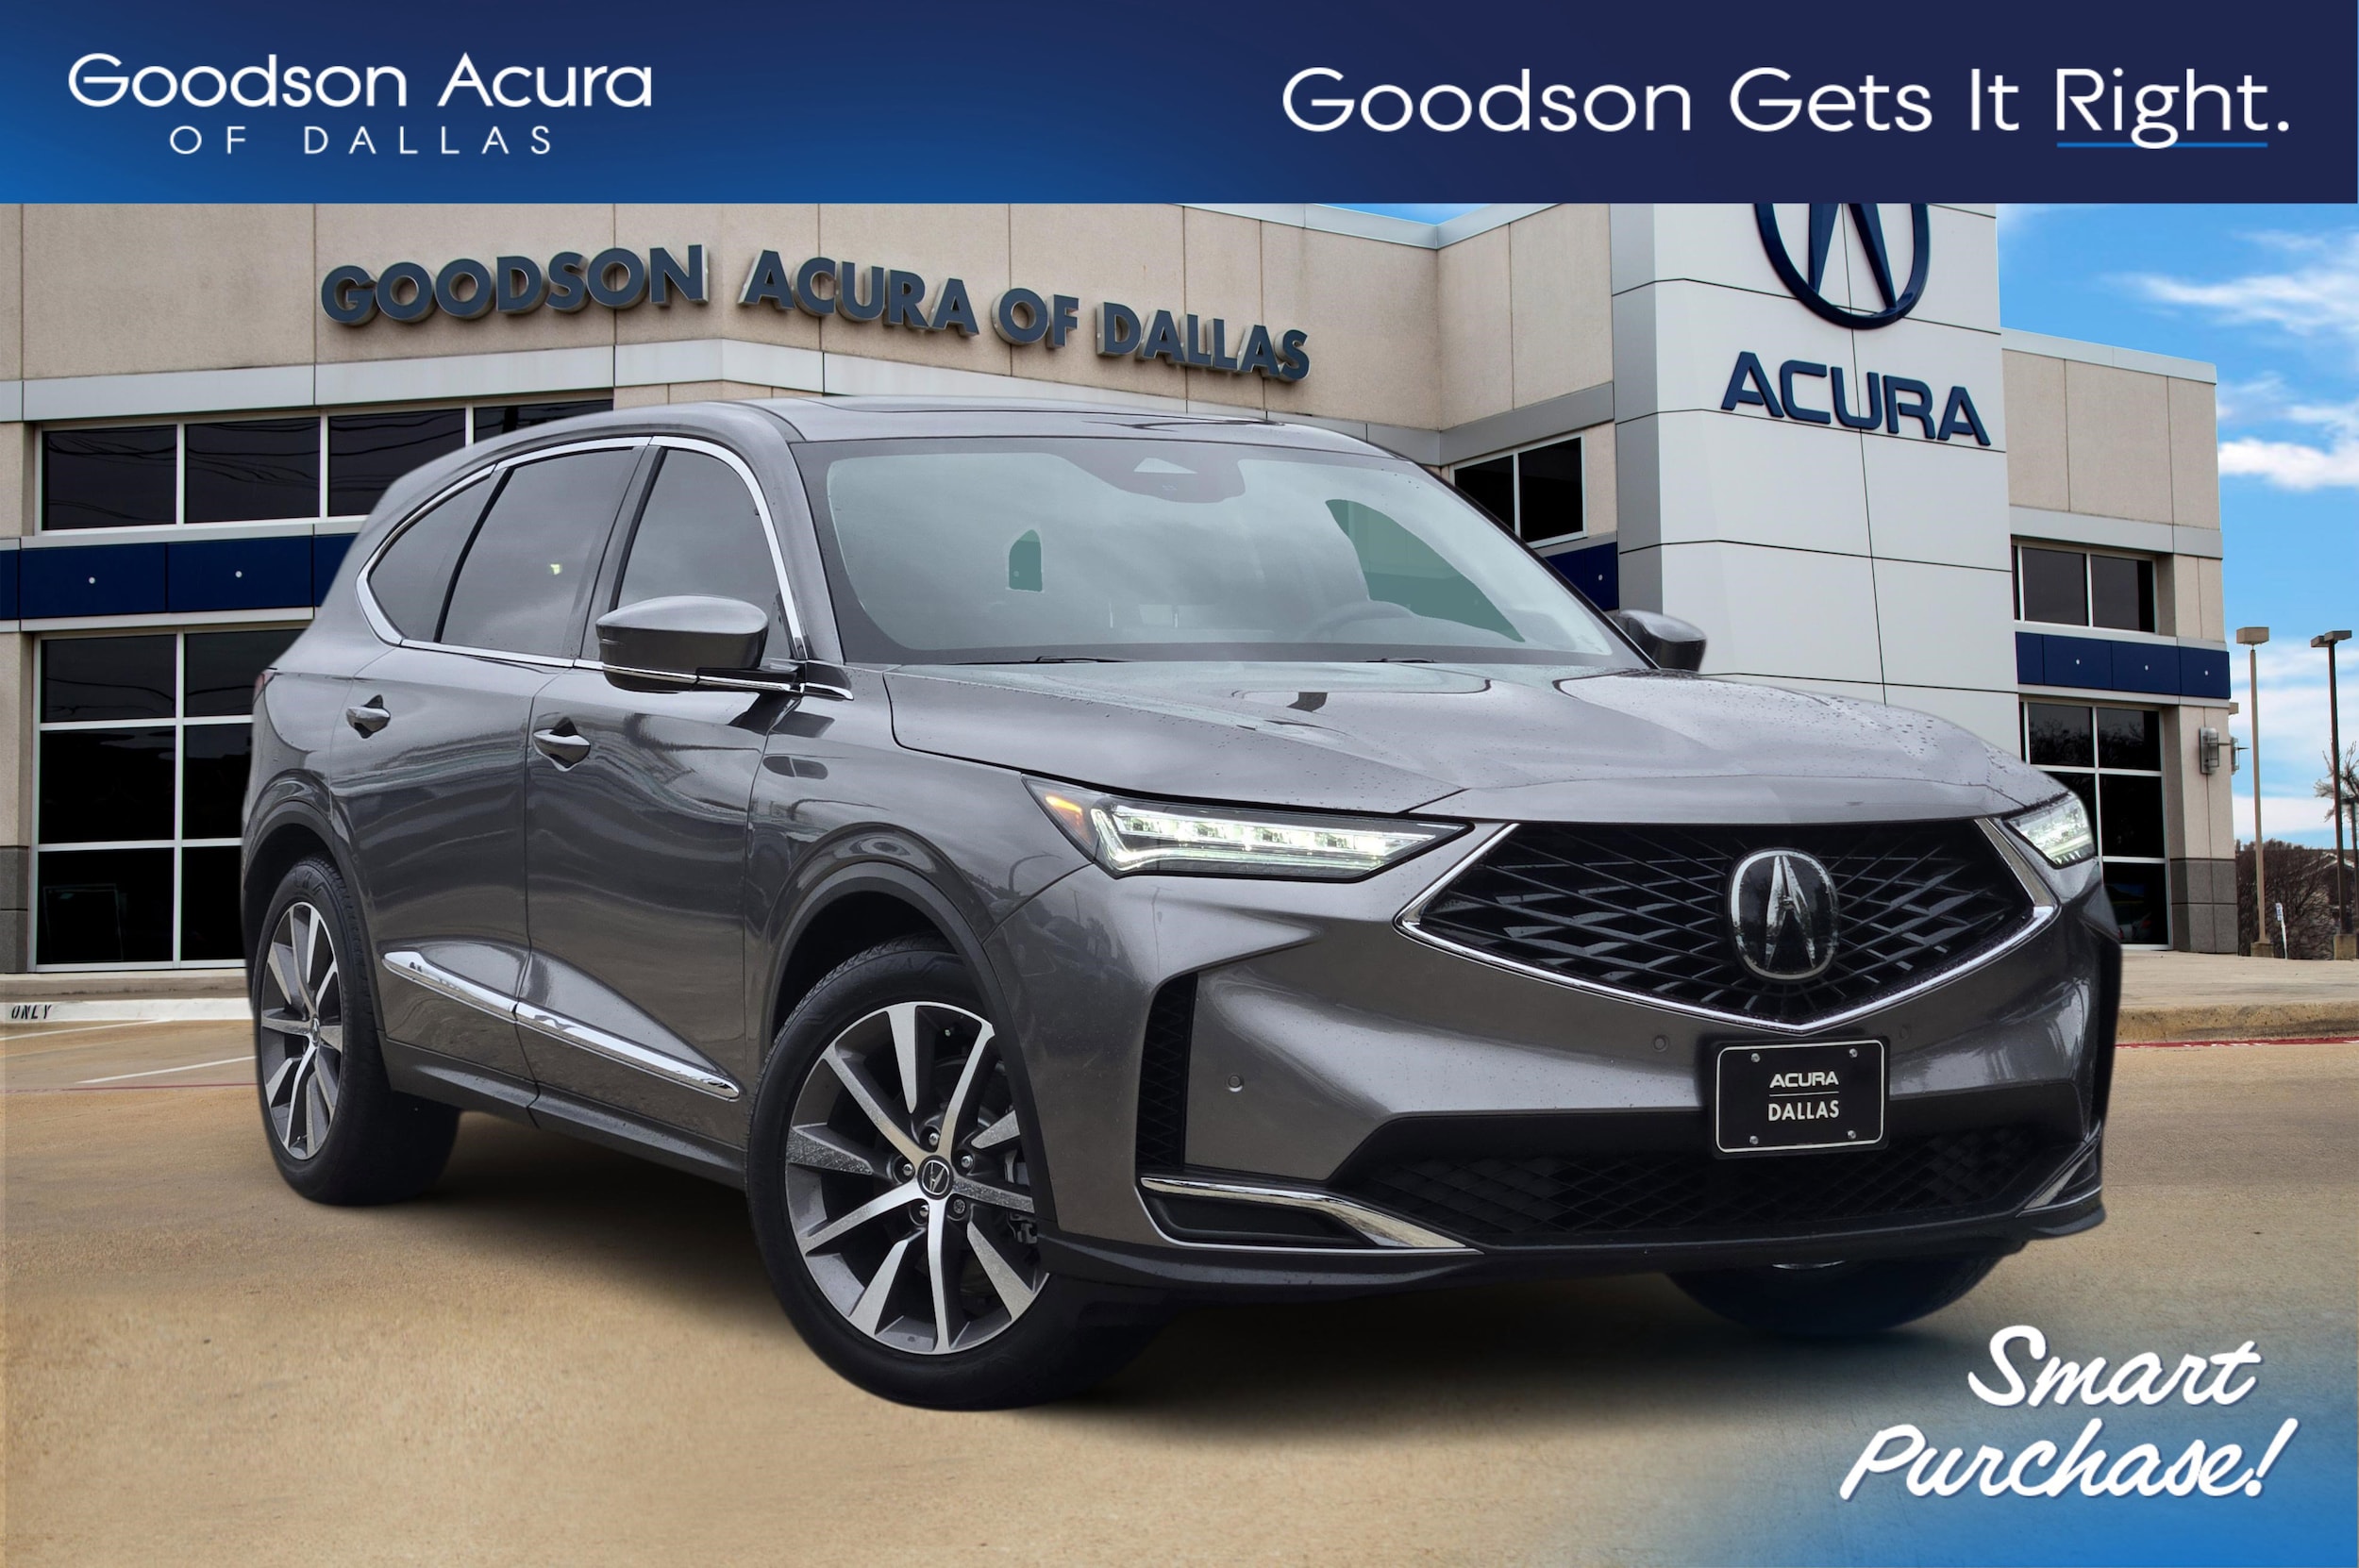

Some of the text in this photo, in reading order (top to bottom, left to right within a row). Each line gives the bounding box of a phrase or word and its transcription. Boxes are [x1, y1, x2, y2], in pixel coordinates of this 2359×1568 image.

[321, 244, 1310, 382] GOODSON ACURA OF DALLAS
[1720, 351, 1991, 446] ACURA
[11, 1004, 52, 1019] ONLY
[1769, 1071, 1839, 1088] ACURA
[1767, 1099, 1839, 1121] DALLAS
